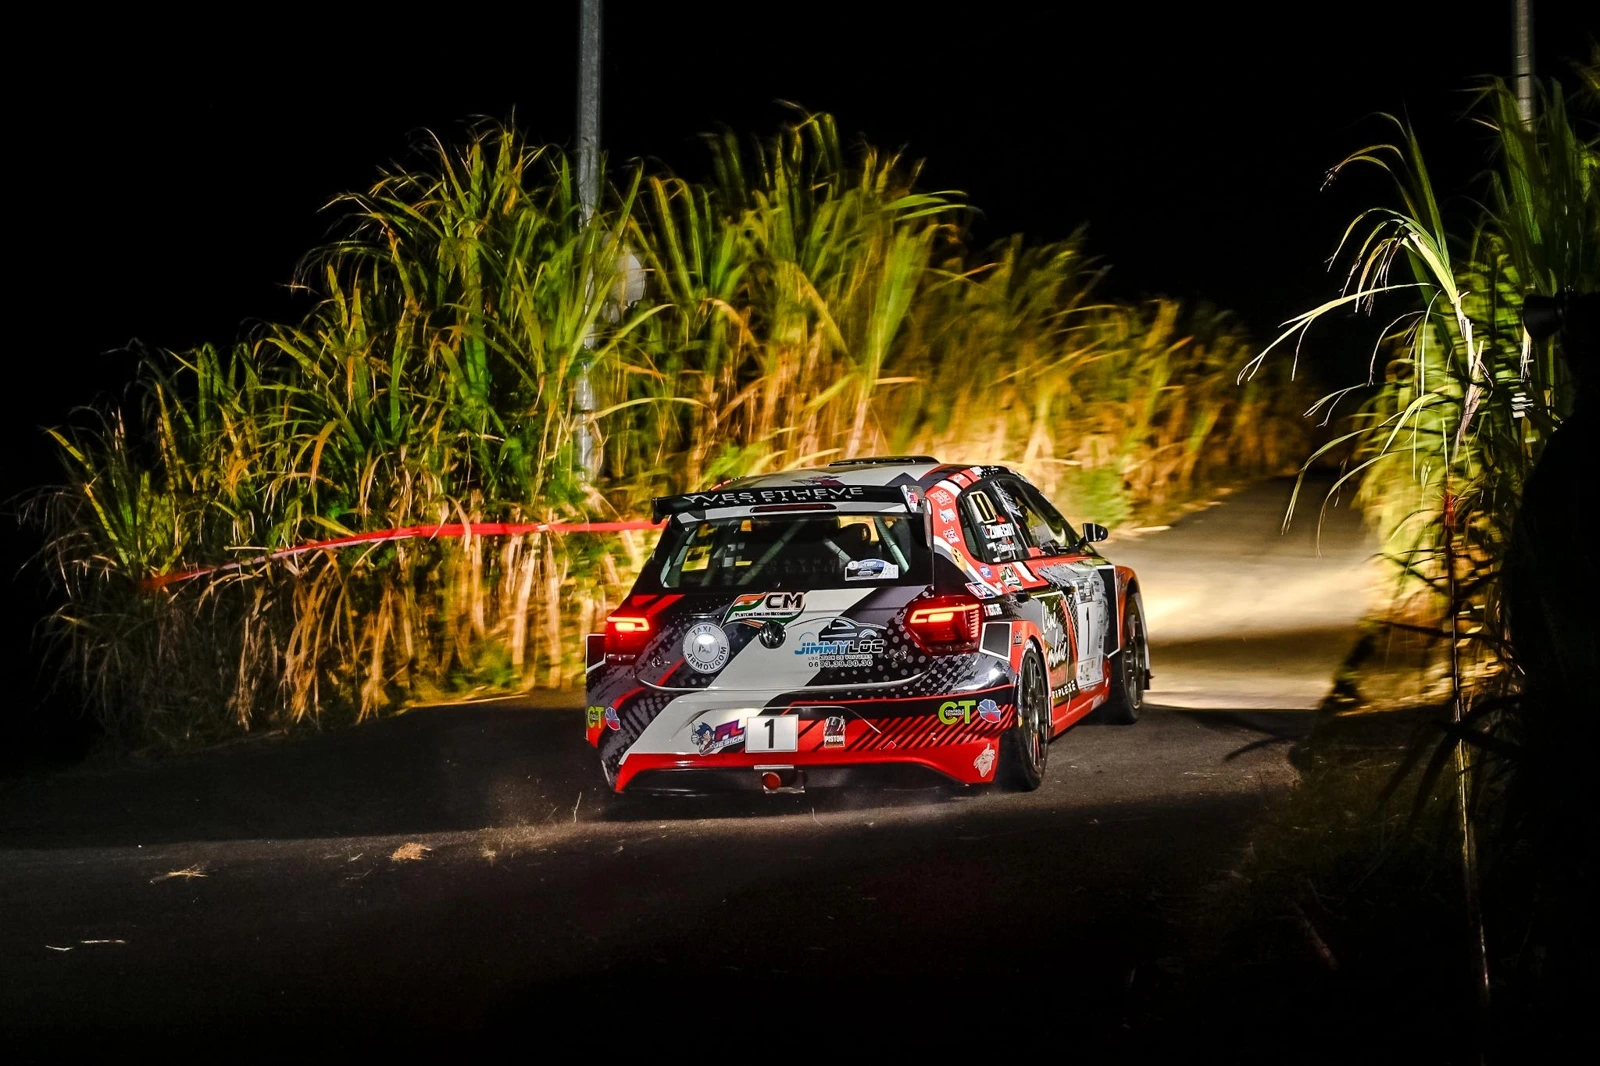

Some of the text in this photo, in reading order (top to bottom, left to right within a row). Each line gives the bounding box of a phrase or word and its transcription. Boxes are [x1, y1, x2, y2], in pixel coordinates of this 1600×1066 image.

[683, 487, 864, 504] YVES ETHEVE
[702, 495, 852, 507] ASSURANCES
[765, 592, 804, 610] CM
[692, 625, 712, 637] TAXI
[1085, 606, 1091, 655] 1
[687, 646, 727, 671] ARMOUGOM
[587, 705, 605, 729] CT
[938, 700, 976, 725] CT
[711, 734, 745, 749] DESIGN
[764, 718, 775, 749] 1
[824, 734, 845, 743] PISTON
